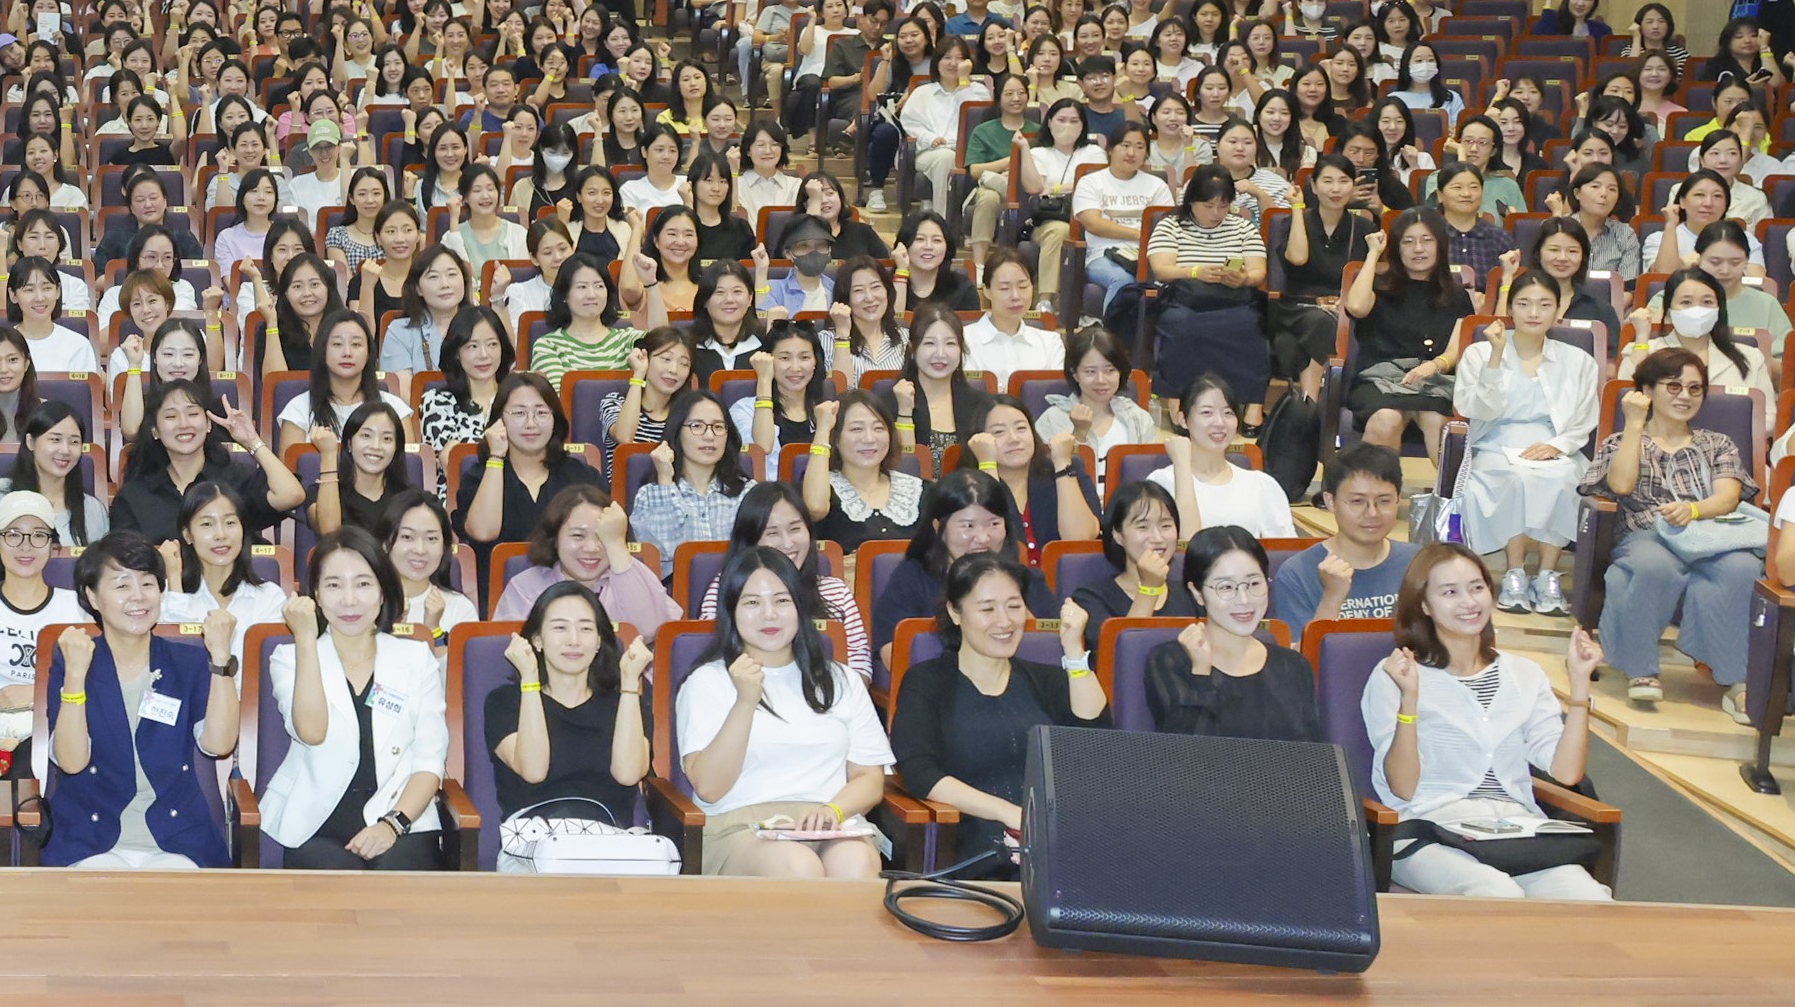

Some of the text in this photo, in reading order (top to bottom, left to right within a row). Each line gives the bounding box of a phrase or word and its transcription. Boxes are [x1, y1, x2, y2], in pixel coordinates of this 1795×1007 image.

[1373, 606, 1393, 619] OF
[183, 625, 202, 633] 3-17
[10, 670, 36, 680] PARIS
